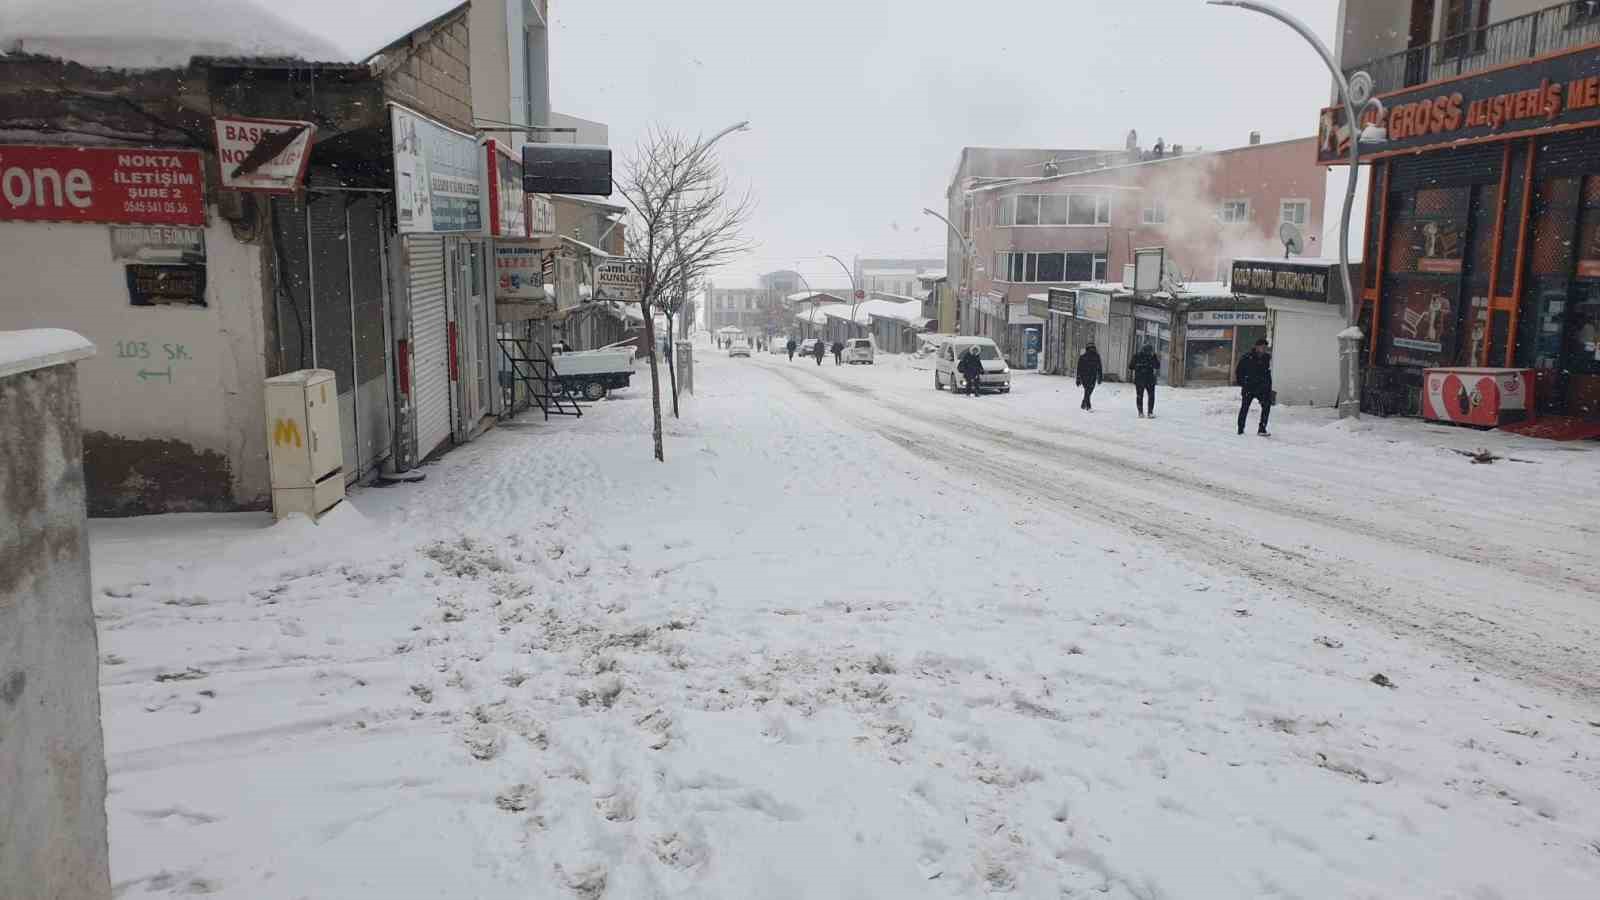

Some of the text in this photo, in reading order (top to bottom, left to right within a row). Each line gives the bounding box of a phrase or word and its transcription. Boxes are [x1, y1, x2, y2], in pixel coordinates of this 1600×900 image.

[1389, 76, 1600, 141] GROSS ALIŞVERİŞ ME
[117, 154, 182, 168] NOKTA
[0, 156, 92, 208] one
[113, 169, 193, 187] İLETİŞİM
[128, 187, 182, 199] ŞUBE 2
[115, 341, 150, 359] 103
